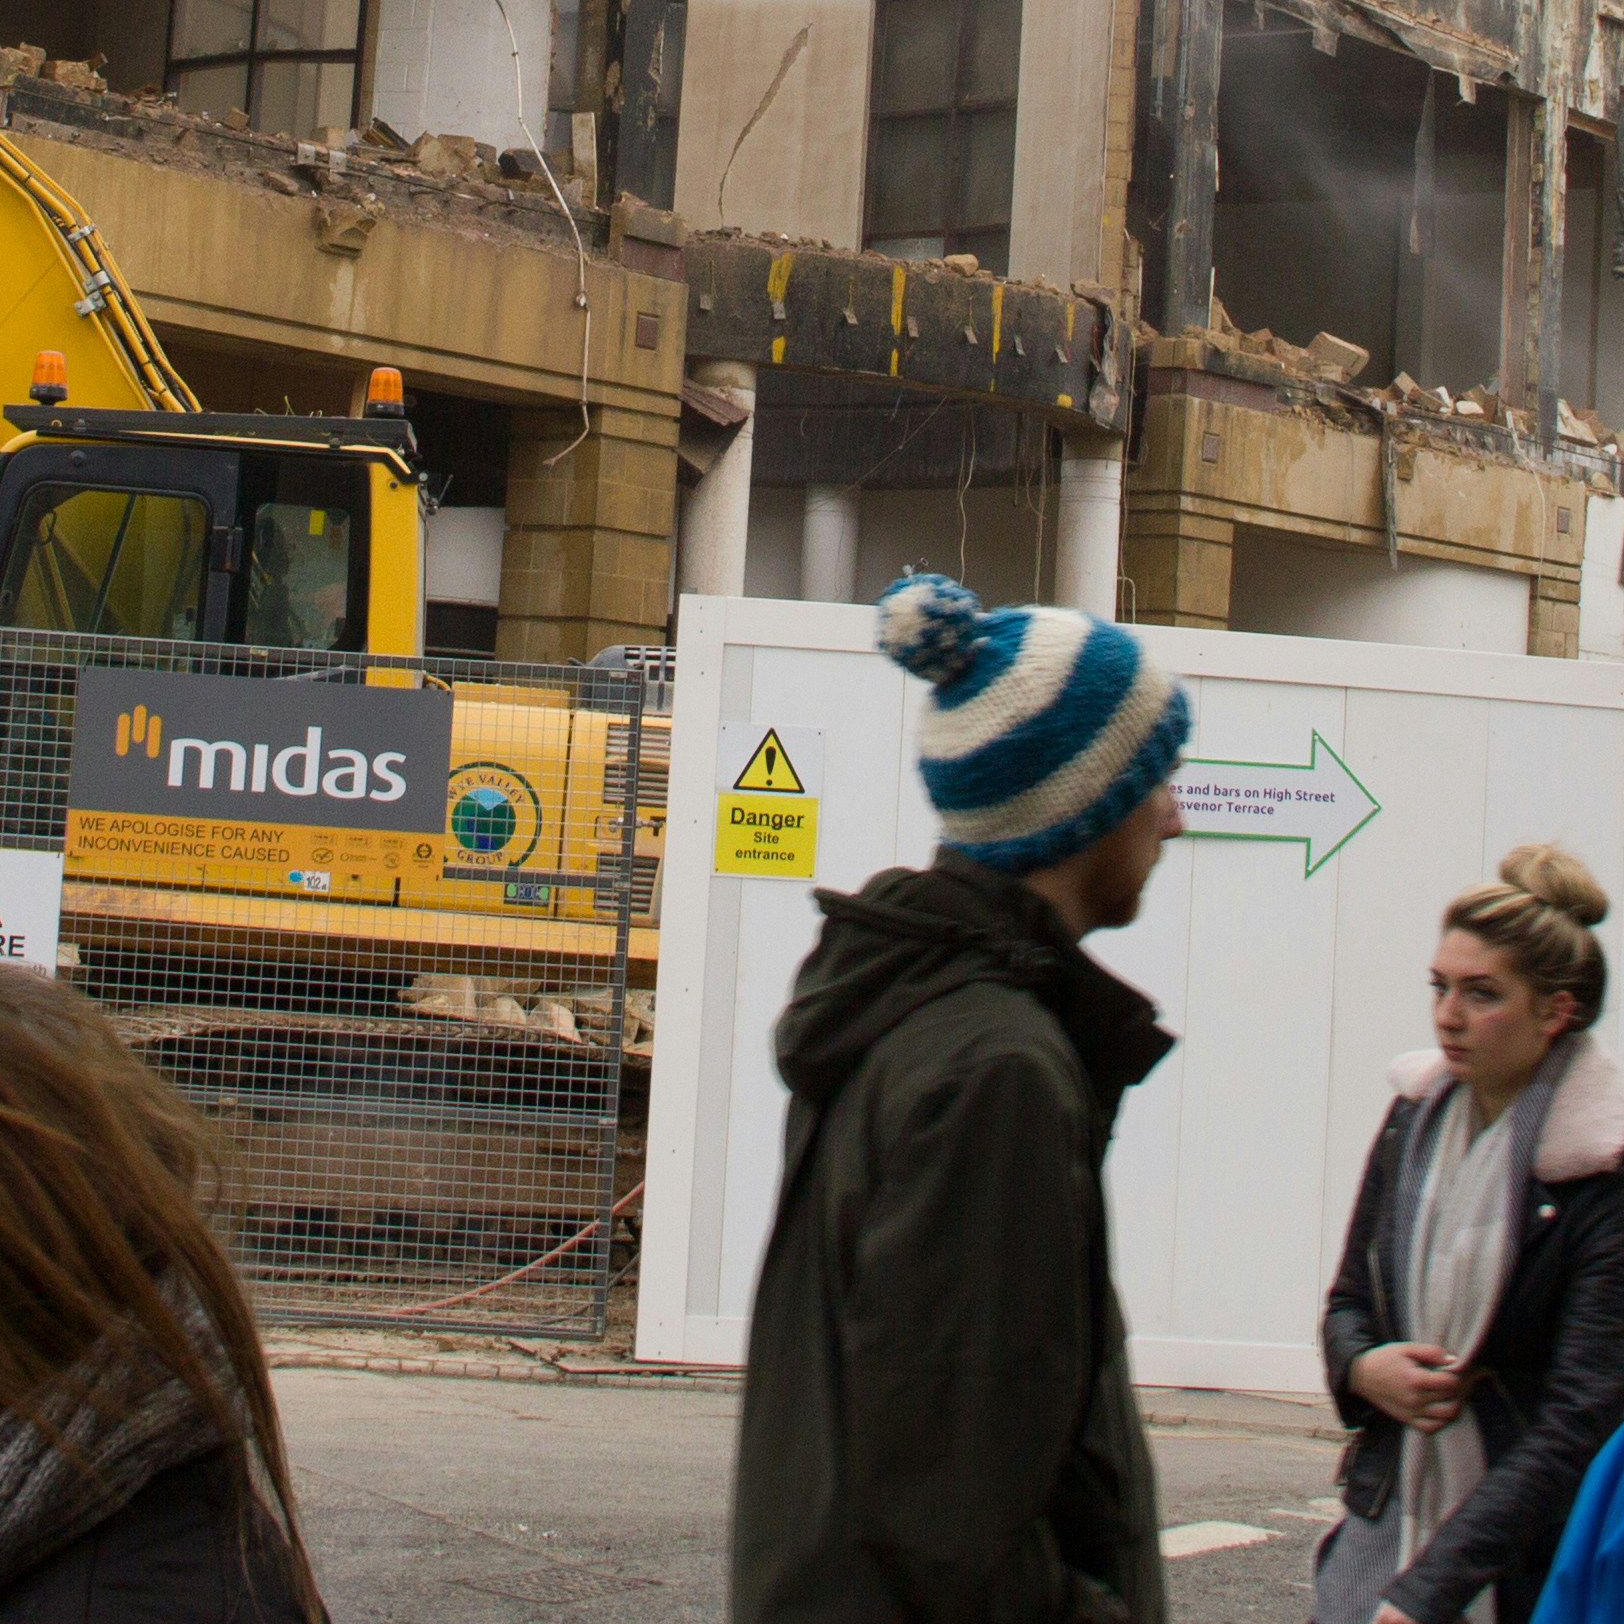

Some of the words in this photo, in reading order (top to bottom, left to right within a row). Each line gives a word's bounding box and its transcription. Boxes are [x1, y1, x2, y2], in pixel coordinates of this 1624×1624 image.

[166, 726, 407, 802] midas
[479, 774, 526, 803] VALLEY
[1186, 784, 1210, 796] and
[1213, 784, 1241, 797] bars
[1244, 789, 1260, 799] on
[1263, 788, 1292, 803] High
[1295, 790, 1336, 803] Street
[730, 807, 805, 830] Danger
[1226, 802, 1275, 815] Terrace
[78, 817, 106, 832] WE
[109, 819, 206, 839] APOLOGISE
[211, 825, 245, 841] FOR
[249, 828, 285, 843] ANY
[753, 831, 780, 844] Site
[78, 835, 216, 858] INCONVENIENCE
[221, 845, 290, 863] CAUSED
[457, 850, 503, 865] GROUP
[735, 848, 795, 861] entrance
